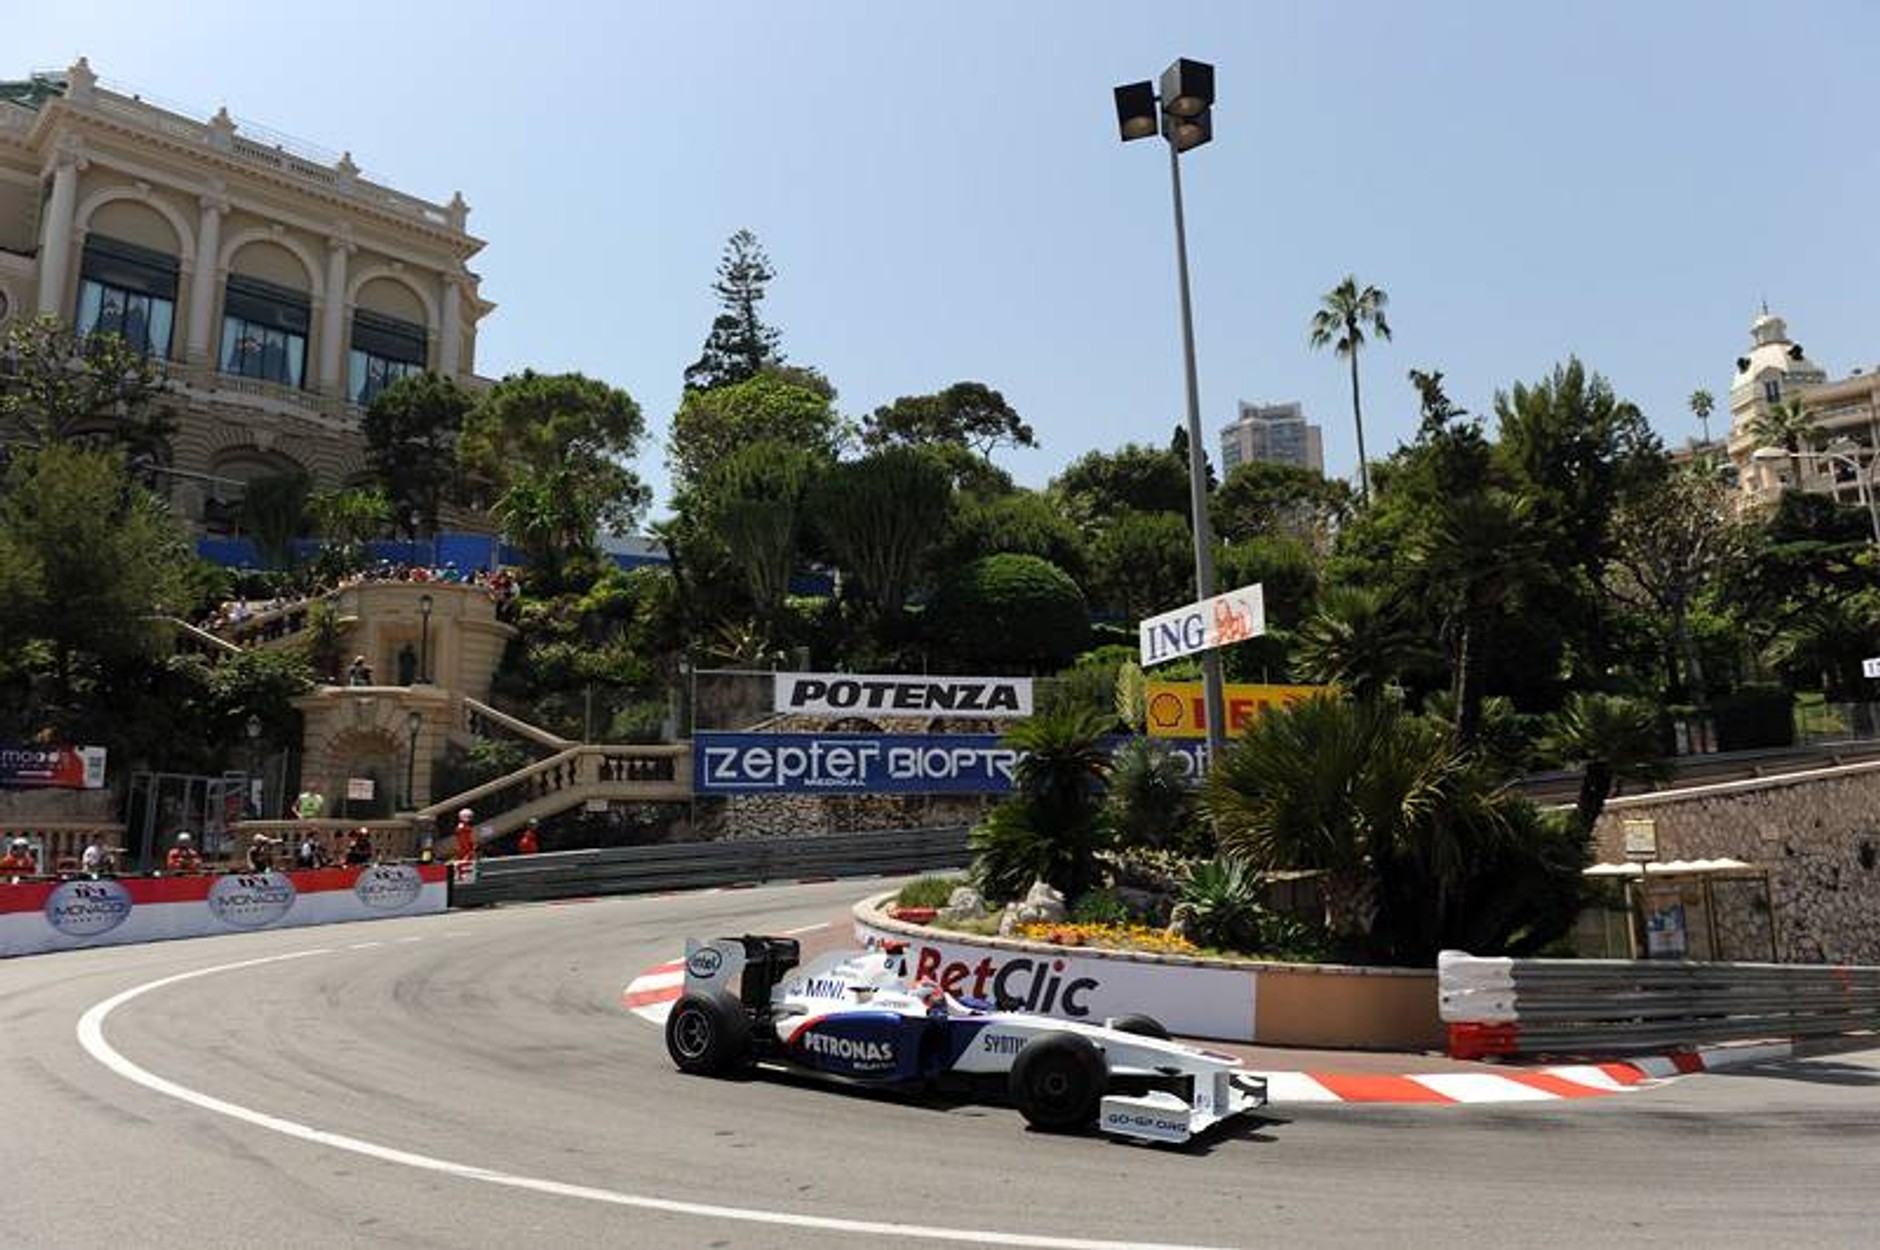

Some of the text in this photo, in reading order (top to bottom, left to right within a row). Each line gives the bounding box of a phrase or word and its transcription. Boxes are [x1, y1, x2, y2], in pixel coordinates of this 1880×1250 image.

[1147, 613, 1204, 660] ING
[789, 679, 1019, 710] POTENZA
[704, 741, 1028, 787] zepter BIOPTR
[915, 946, 1099, 1017] BetClic
[804, 1031, 893, 1061] PETRONAS
